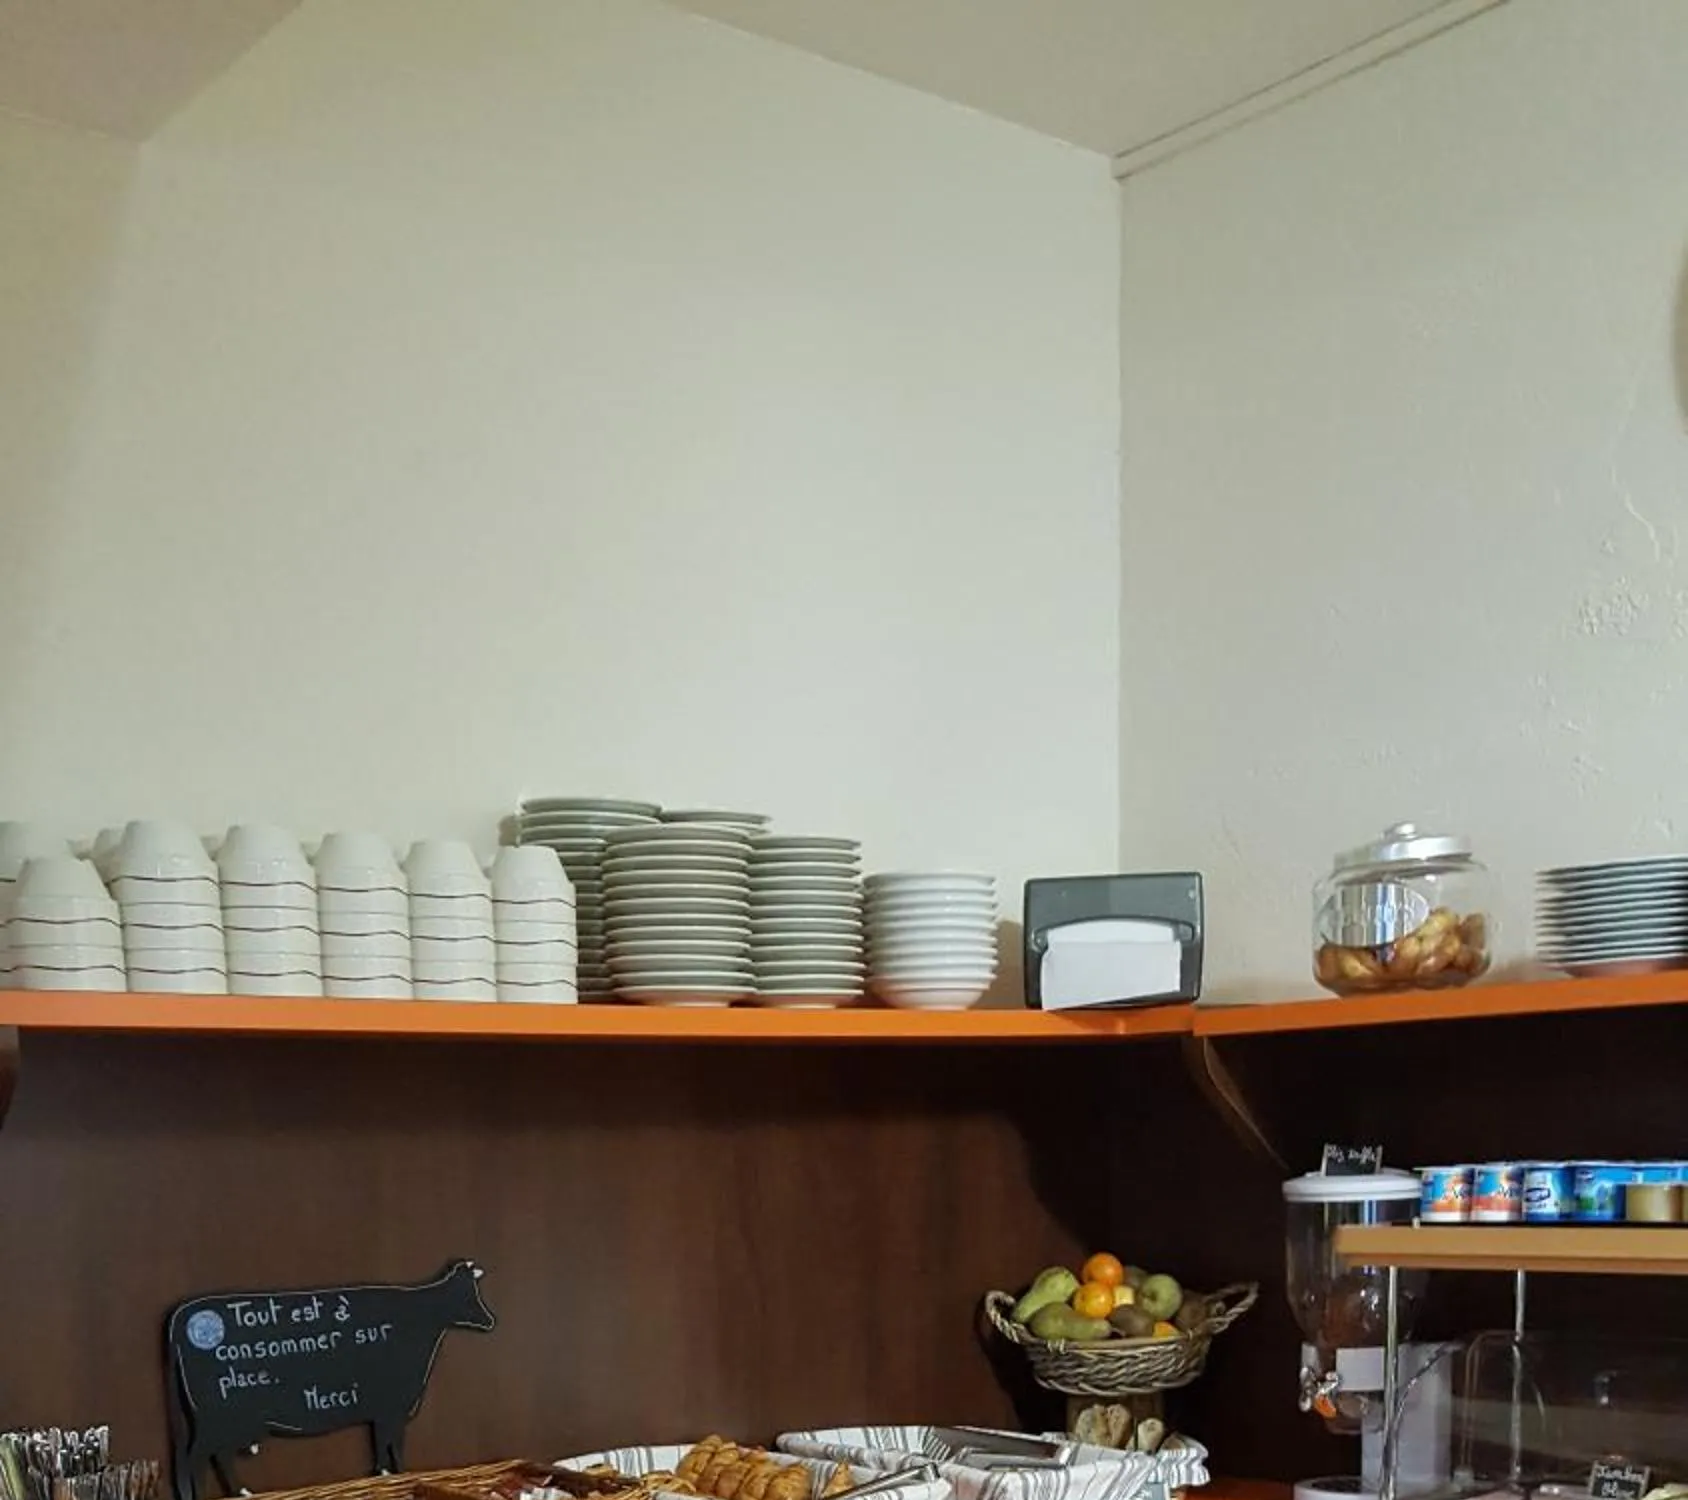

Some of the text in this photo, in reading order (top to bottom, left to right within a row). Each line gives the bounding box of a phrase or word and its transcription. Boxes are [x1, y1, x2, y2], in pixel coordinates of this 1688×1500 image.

[226, 1295, 352, 1328] Tout est à
[214, 1323, 393, 1361] consommer sur
[218, 1366, 281, 1400] place.
[303, 1382, 360, 1410] Merci
